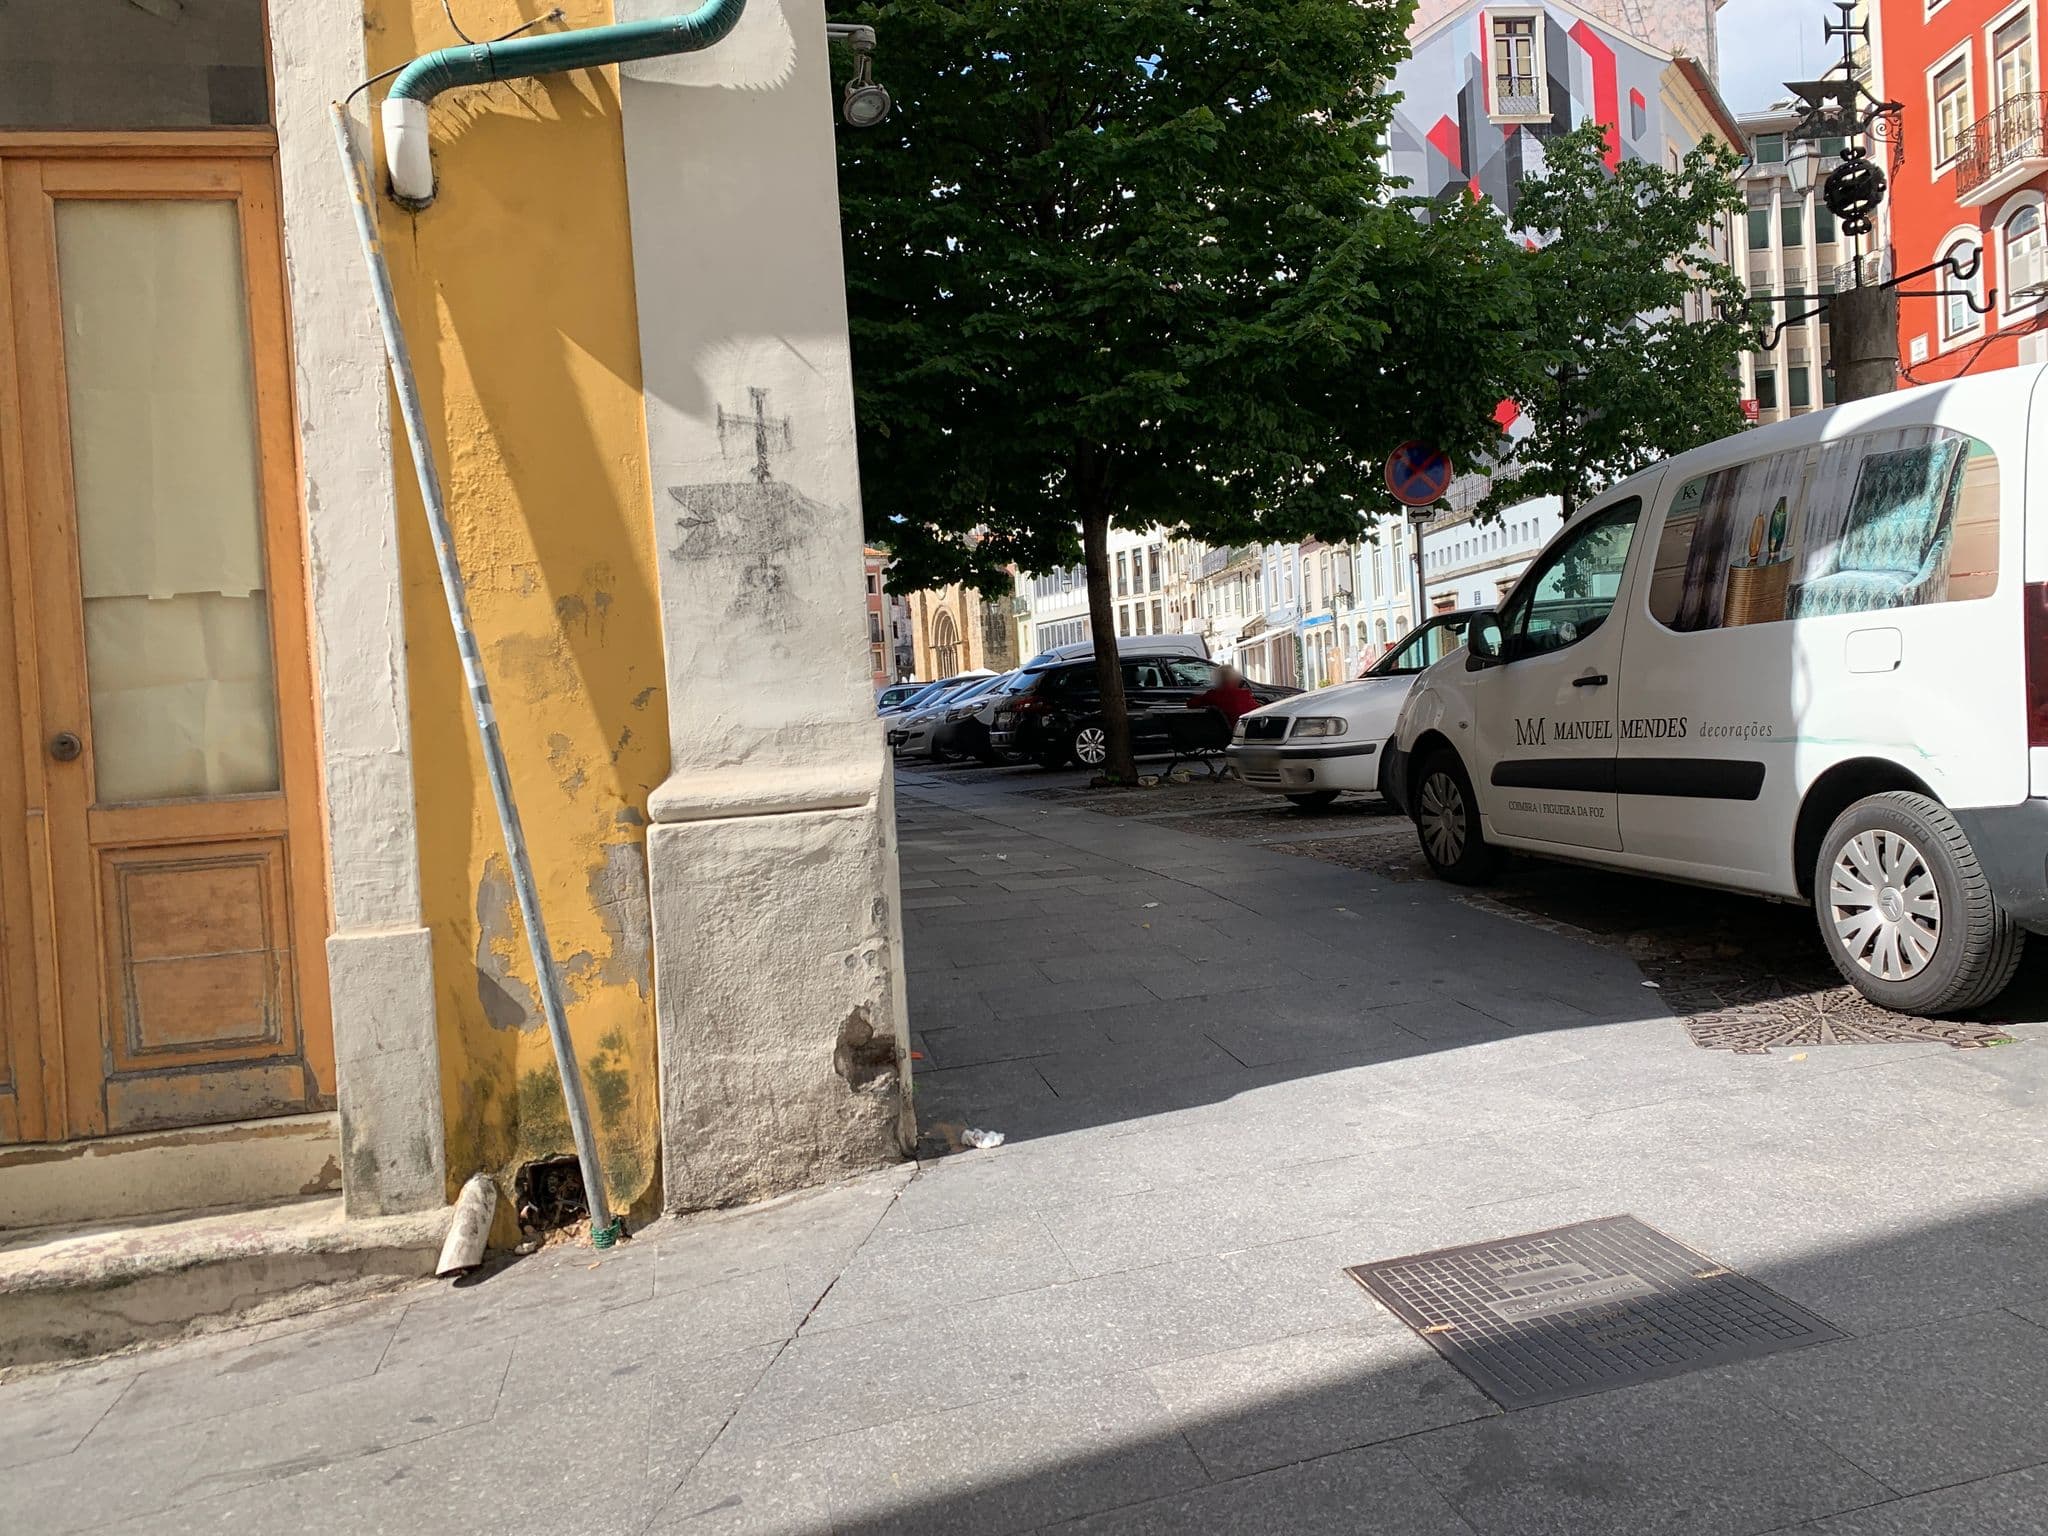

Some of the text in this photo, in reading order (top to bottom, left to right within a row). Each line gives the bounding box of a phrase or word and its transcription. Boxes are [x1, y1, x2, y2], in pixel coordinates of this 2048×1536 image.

[1553, 720, 1613, 740] MANUEL
[1620, 716, 1688, 739] MENDES
[1699, 721, 1773, 741] decorações
[1508, 801, 1605, 818] COIMBRA FIGUEIRA DA FOZ
[1503, 1279, 1643, 1316] ELECTRICIDADE
